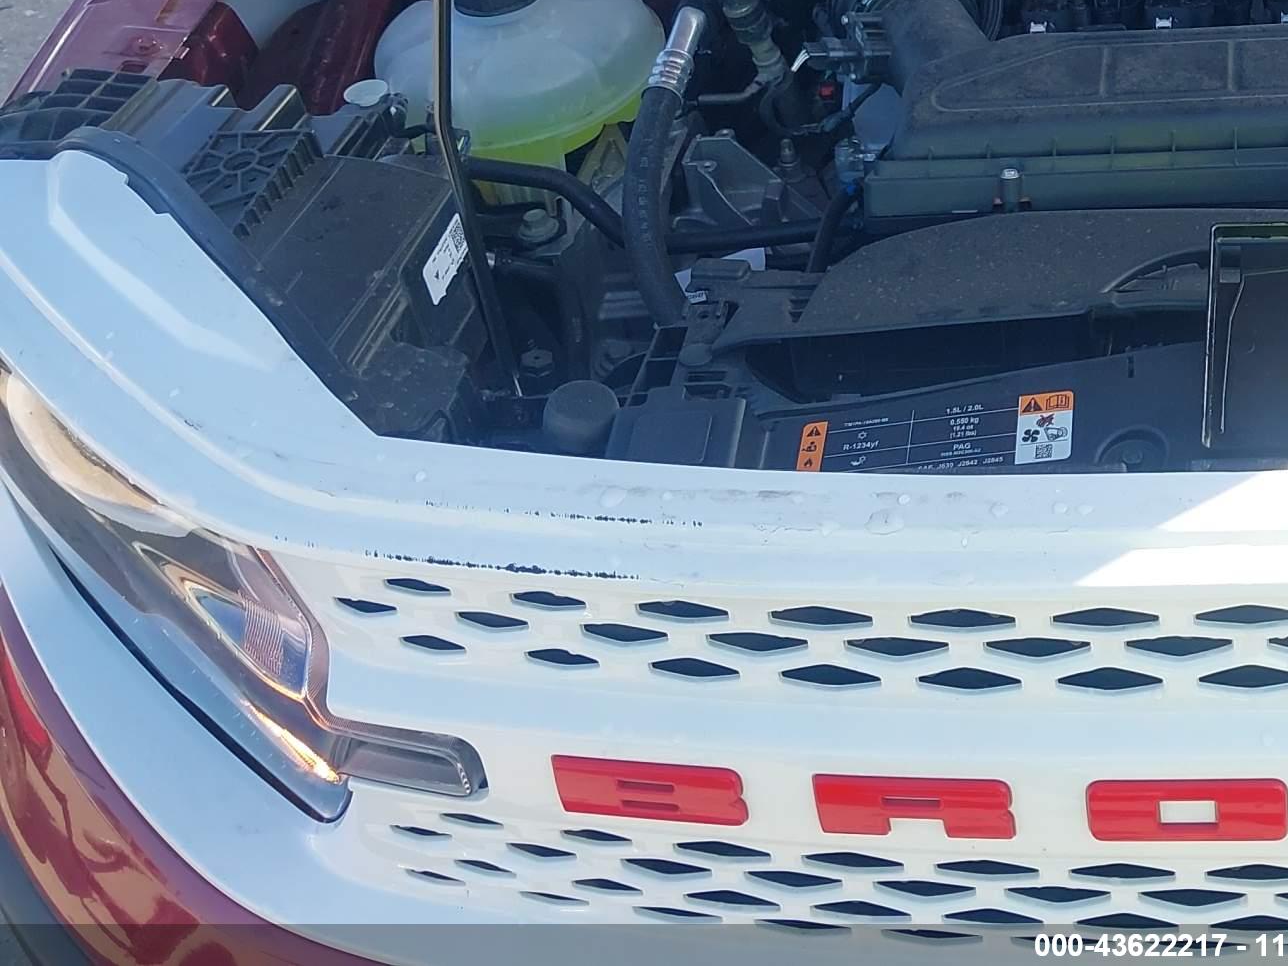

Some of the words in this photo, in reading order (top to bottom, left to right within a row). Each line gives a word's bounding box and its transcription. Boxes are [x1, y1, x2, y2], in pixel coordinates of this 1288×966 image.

[970, 416, 980, 424] kg
[843, 440, 880, 451] R-1234yf
[953, 442, 971, 450] PAG
